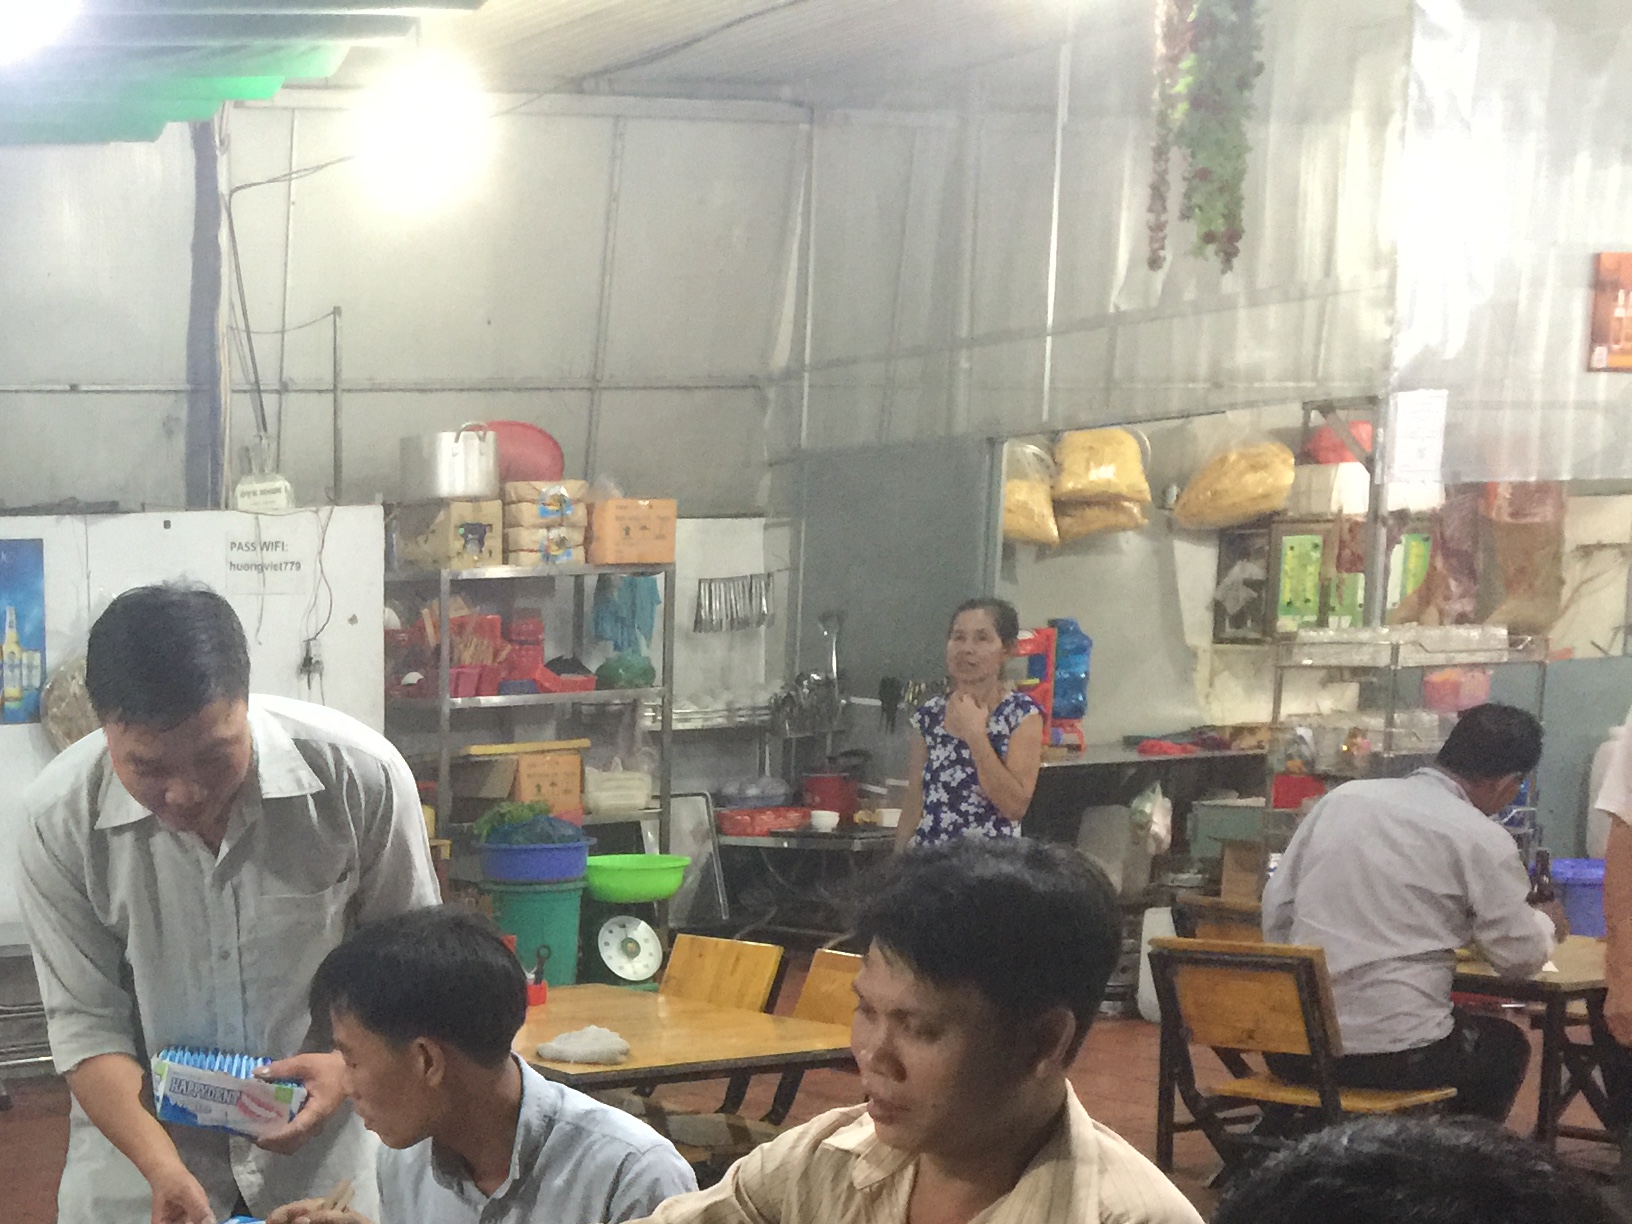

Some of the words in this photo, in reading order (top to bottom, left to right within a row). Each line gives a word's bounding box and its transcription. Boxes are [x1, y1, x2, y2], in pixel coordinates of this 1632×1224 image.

[230, 541, 257, 552] PASS
[260, 541, 289, 552] WIFI:
[229, 561, 302, 573] huongviet779
[169, 1077, 242, 1106] HAPPYDENT
